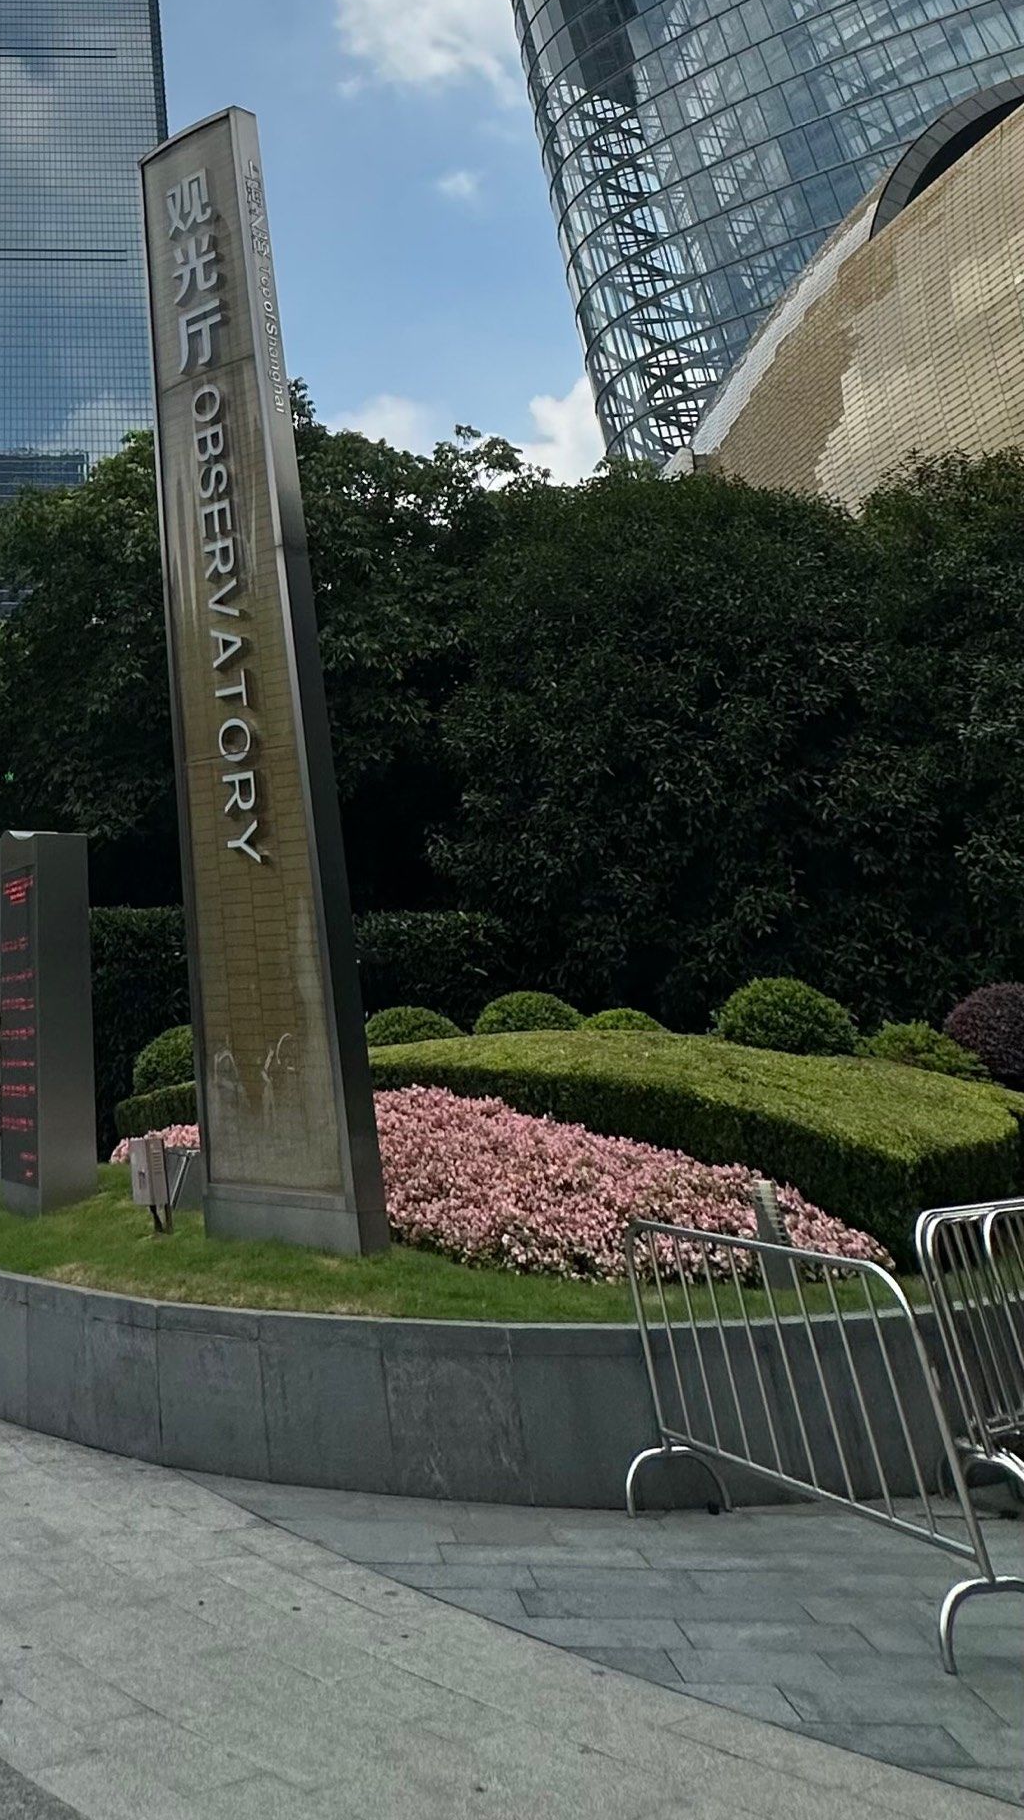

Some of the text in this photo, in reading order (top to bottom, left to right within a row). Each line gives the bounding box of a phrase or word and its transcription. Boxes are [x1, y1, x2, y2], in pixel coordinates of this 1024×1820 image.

[166, 168, 224, 374] 观光厅
[259, 267, 285, 414] Top of Shanghai
[192, 384, 262, 864] OBSERVATORY
